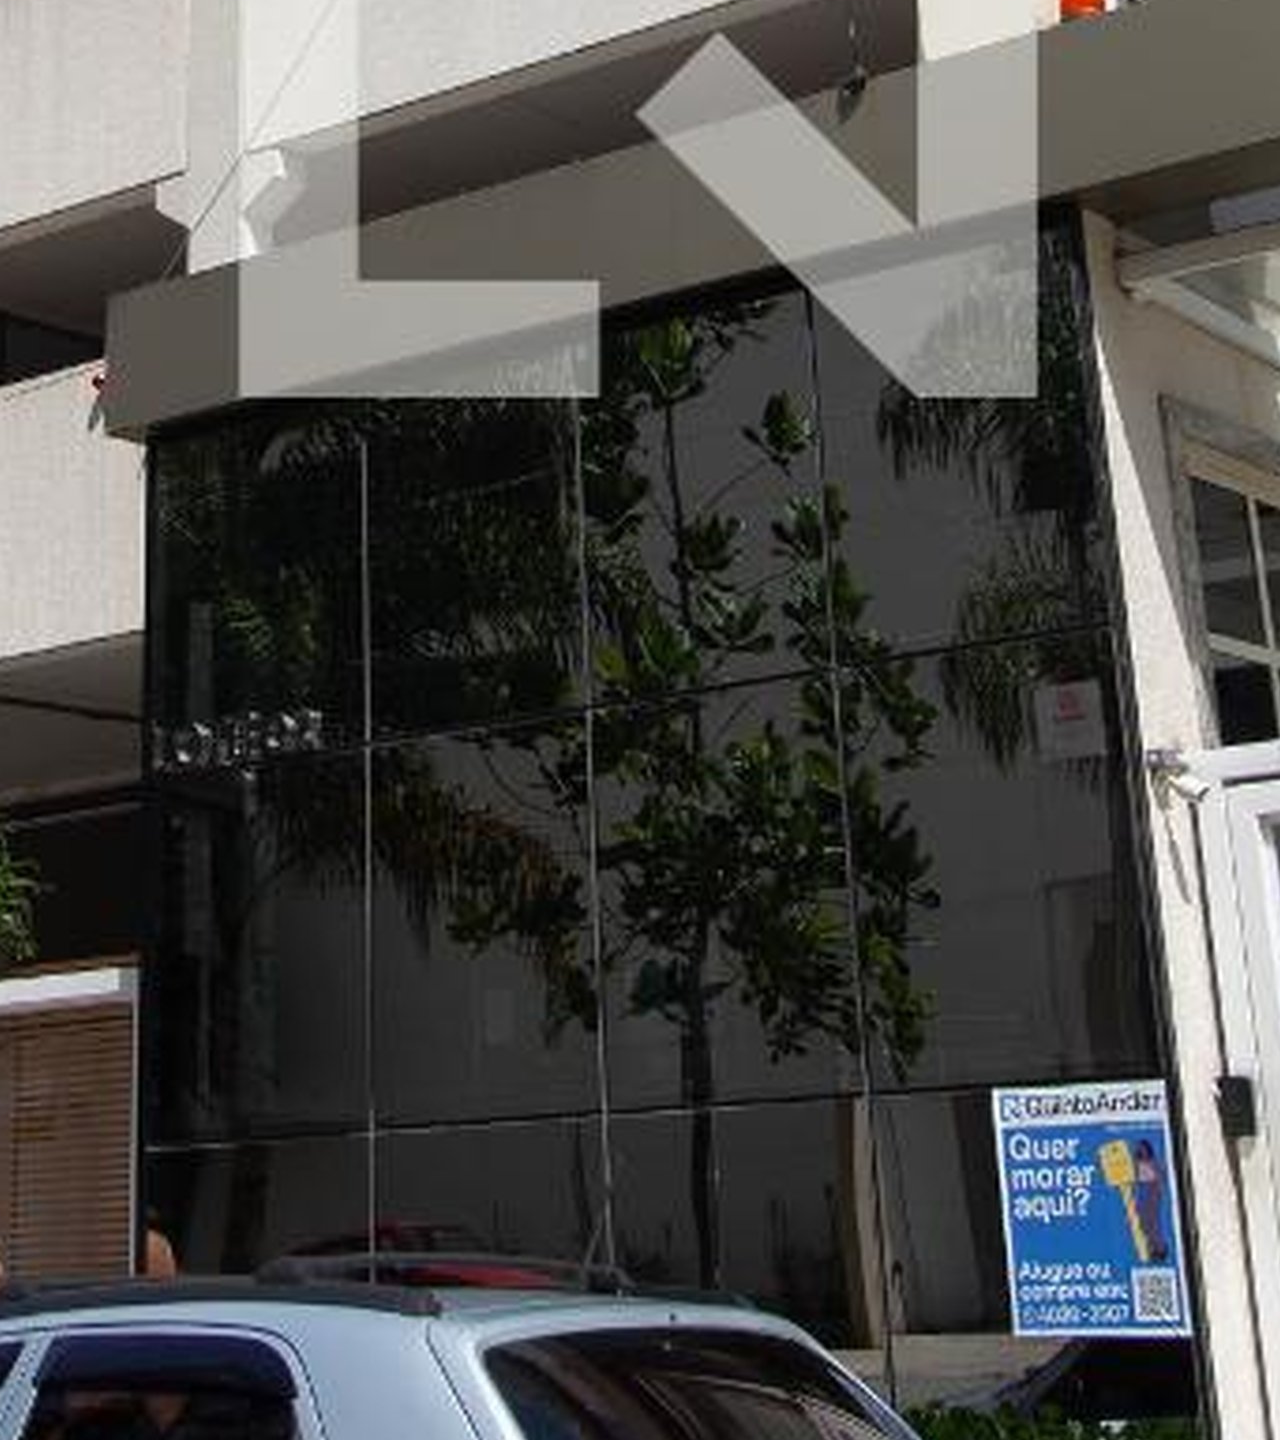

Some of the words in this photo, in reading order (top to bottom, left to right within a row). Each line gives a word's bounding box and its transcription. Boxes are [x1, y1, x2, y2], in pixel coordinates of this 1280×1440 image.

[1009, 1132, 1080, 1161] Quer
[1011, 1163, 1095, 1191] morar
[1013, 1188, 1092, 1224] aqui?
